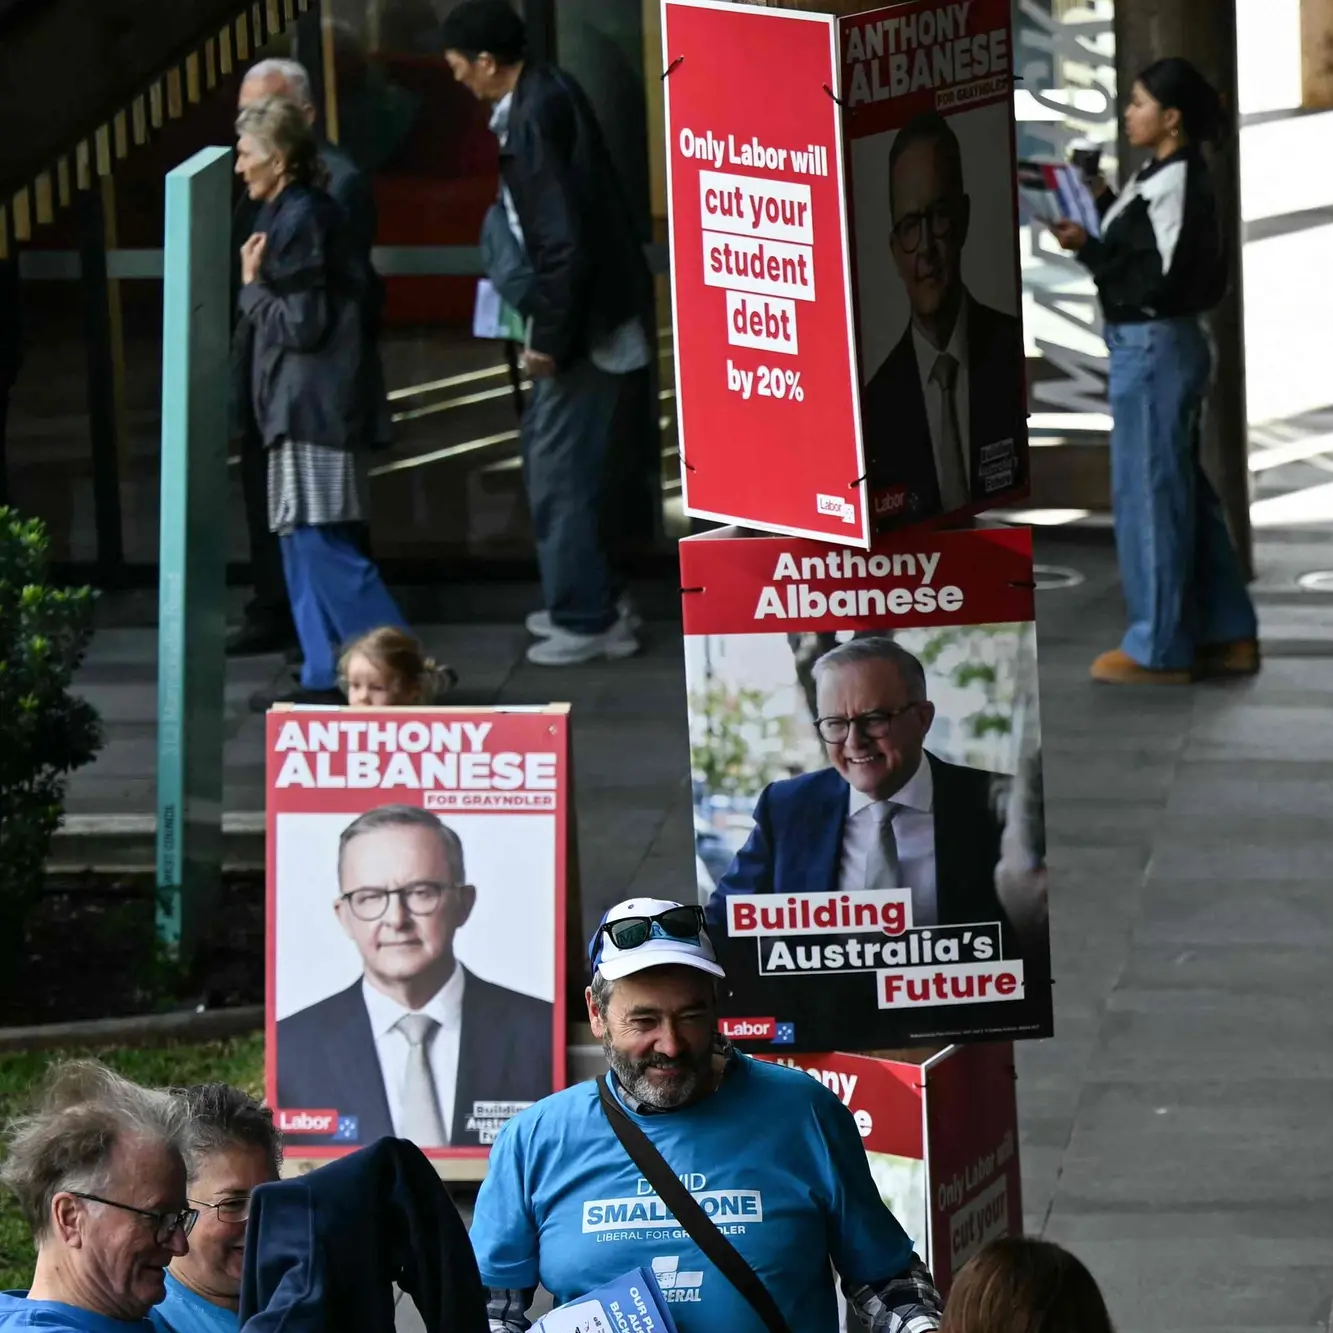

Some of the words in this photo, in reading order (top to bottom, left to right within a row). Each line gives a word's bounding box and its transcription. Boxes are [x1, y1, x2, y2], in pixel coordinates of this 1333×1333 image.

[846, 2, 971, 64] ANTHONY
[848, 28, 1008, 108] ALBANESE
[680, 128, 725, 168] Only
[729, 134, 787, 170] Labor
[791, 144, 828, 176] will
[705, 187, 744, 218] cut
[750, 194, 807, 229] your
[711, 244, 808, 286] student
[733, 299, 791, 341] debt
[726, 360, 753, 399] by
[757, 365, 804, 402] 20%
[820, 496, 842, 513] Labor
[773, 551, 941, 584] Anthony
[754, 585, 964, 619] Albanese
[275, 721, 492, 753] ANTHONY
[275, 752, 556, 789] ALBANESE
[427, 795, 457, 806] FOR
[462, 795, 552, 806] GRAYNDLER
[733, 896, 905, 935] Building
[766, 931, 993, 970] Australia's
[885, 971, 1017, 1002] Future
[723, 1021, 769, 1036] Labor
[280, 1113, 331, 1130] Labor
[636, 1173, 706, 1196] DID
[938, 1178, 963, 1212] Only
[965, 1151, 995, 1189] Labor
[587, 1196, 757, 1225] SMALLONE
[597, 1230, 643, 1243] LIBERAL
[646, 1230, 670, 1240] FOR
[672, 1226, 746, 1239] GRDLER
[952, 1220, 975, 1256] cut
[629, 1286, 648, 1320] OUR
[661, 1288, 702, 1303] BERAL
